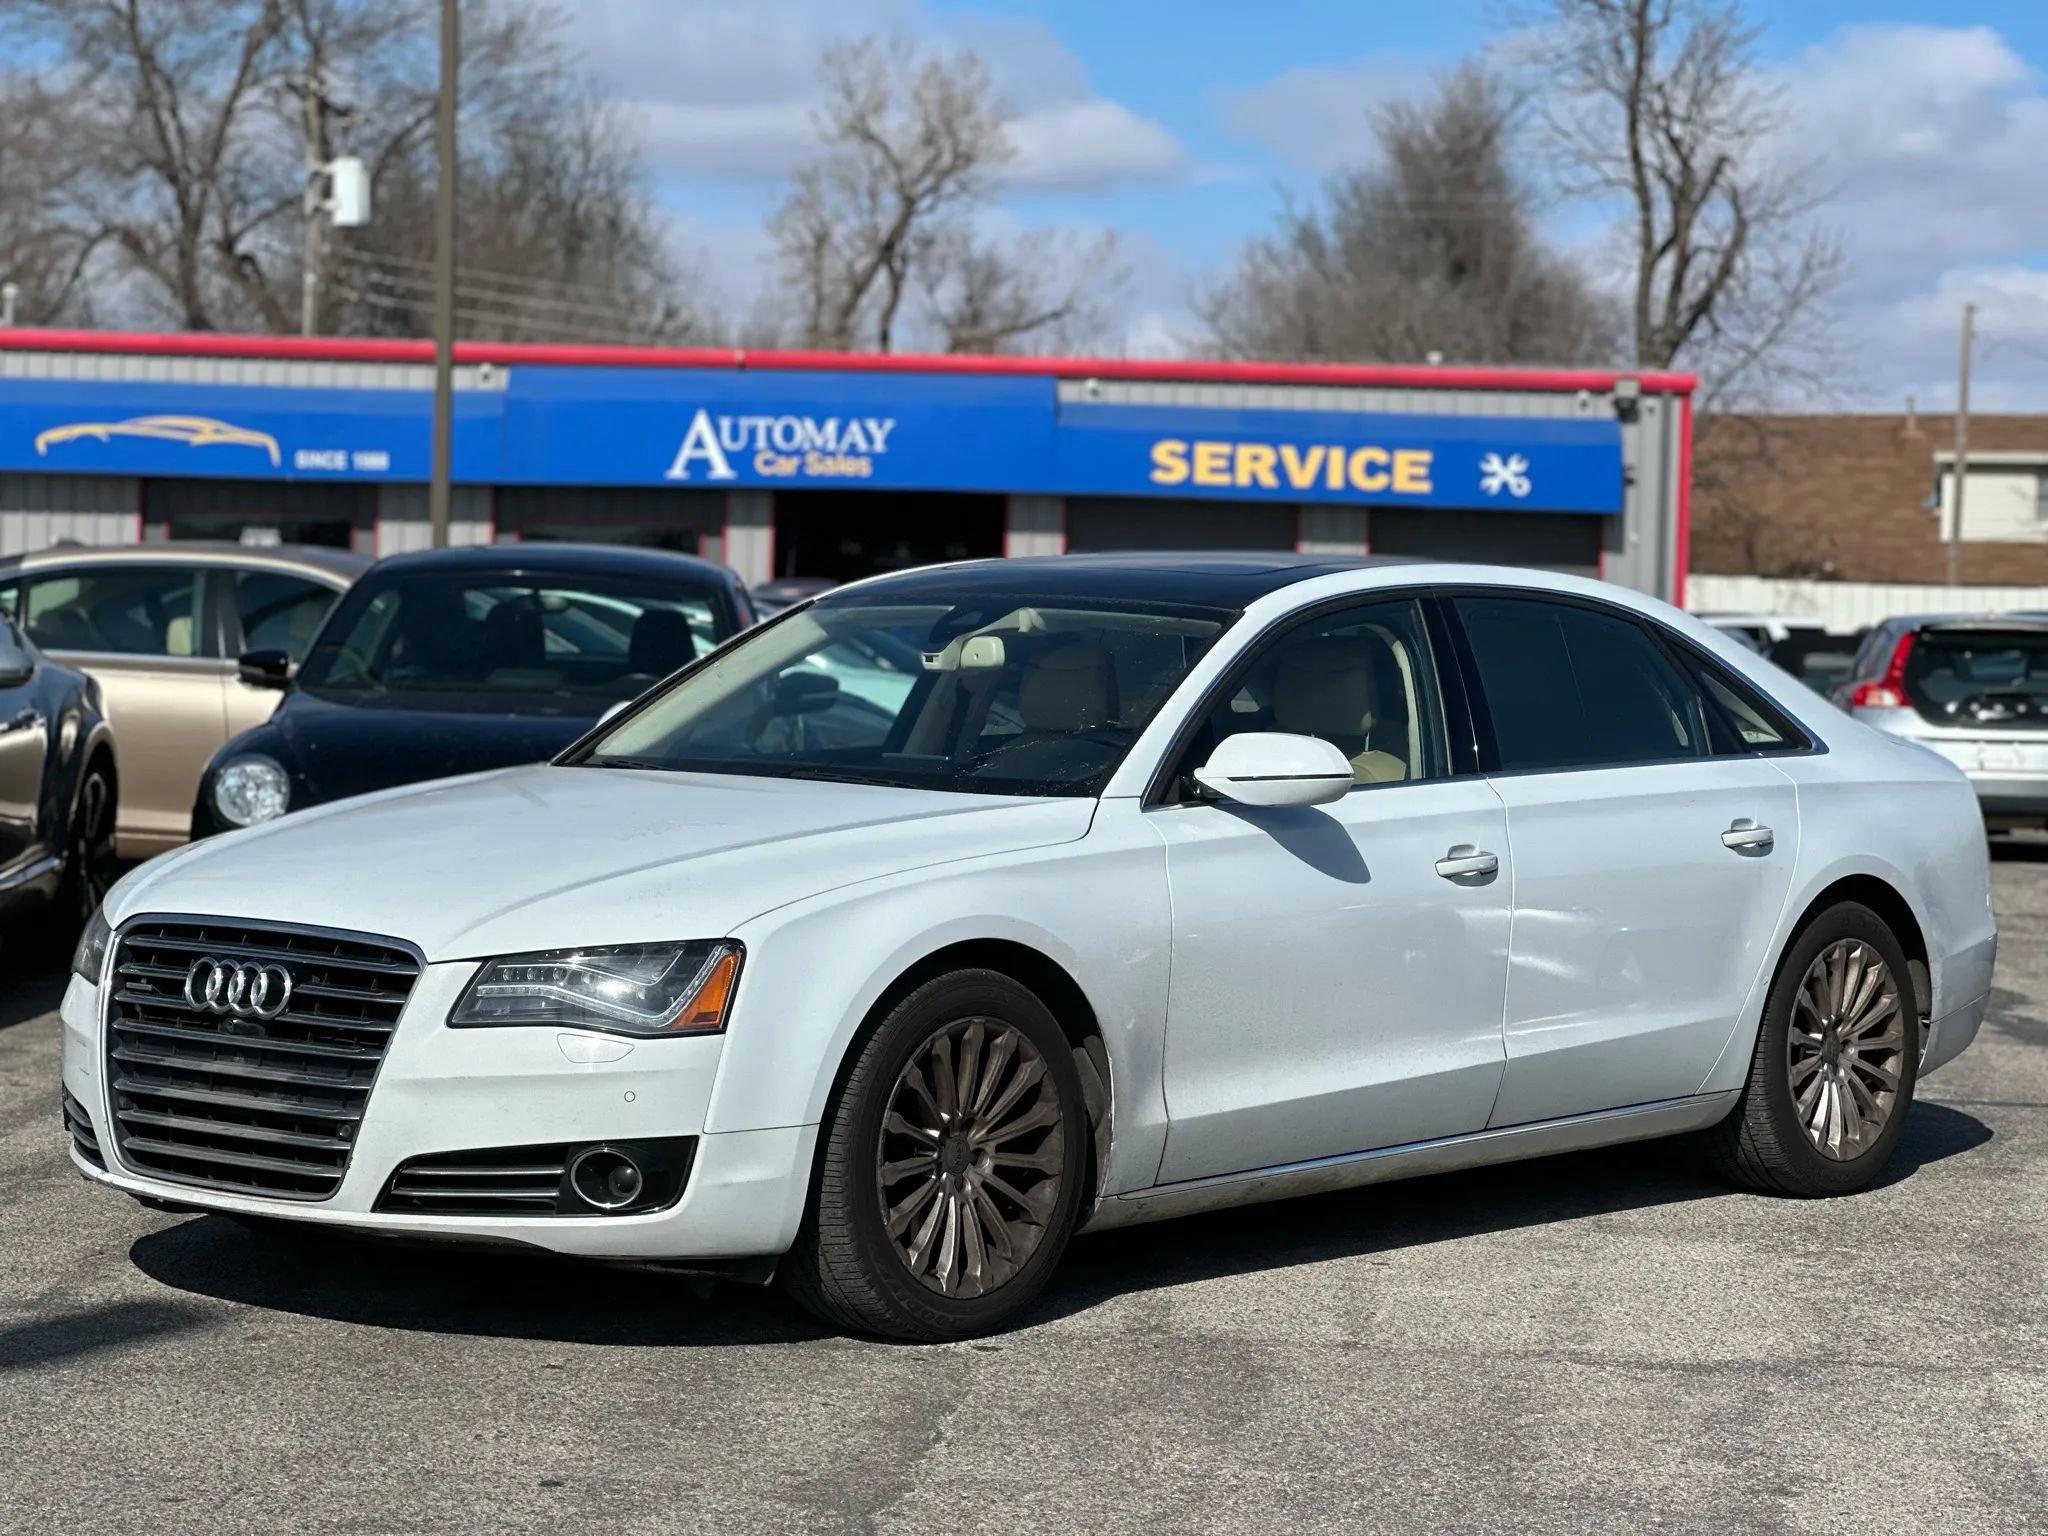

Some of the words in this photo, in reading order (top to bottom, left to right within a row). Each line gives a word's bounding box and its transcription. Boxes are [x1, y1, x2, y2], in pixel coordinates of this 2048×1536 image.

[295, 450, 348, 471] SINCE
[665, 408, 895, 479] AUTOMAY
[754, 451, 800, 476] Car
[804, 452, 872, 478] Sales
[1150, 439, 1433, 494] SERVICE
